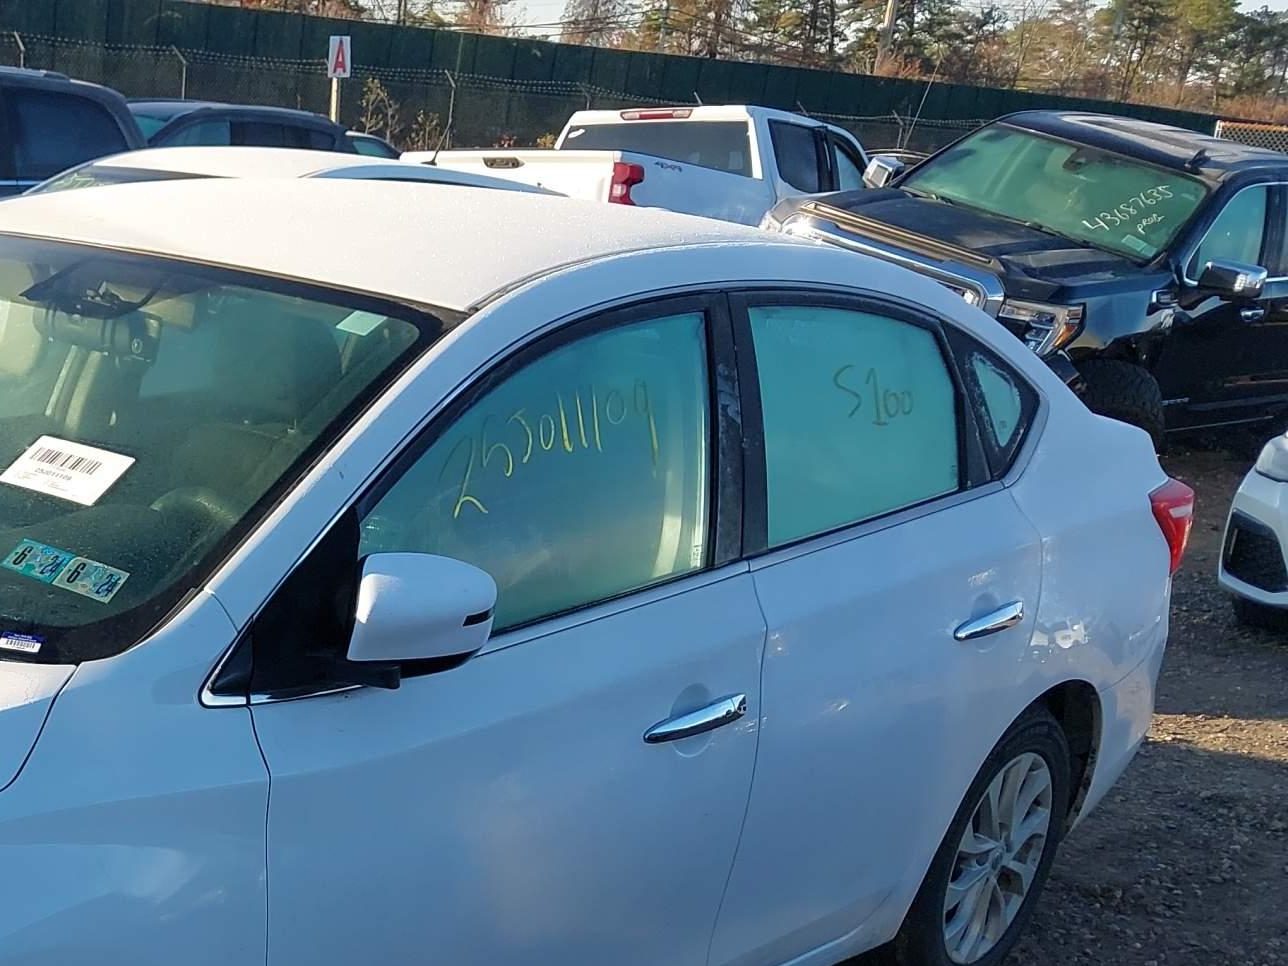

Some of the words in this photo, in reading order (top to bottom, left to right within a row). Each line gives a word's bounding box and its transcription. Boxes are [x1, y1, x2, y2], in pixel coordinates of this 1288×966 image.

[332, 38, 346, 74] A
[1081, 184, 1174, 231] 43687635
[833, 364, 915, 427] S100
[12, 546, 34, 566] 6
[66, 562, 87, 584] 6
